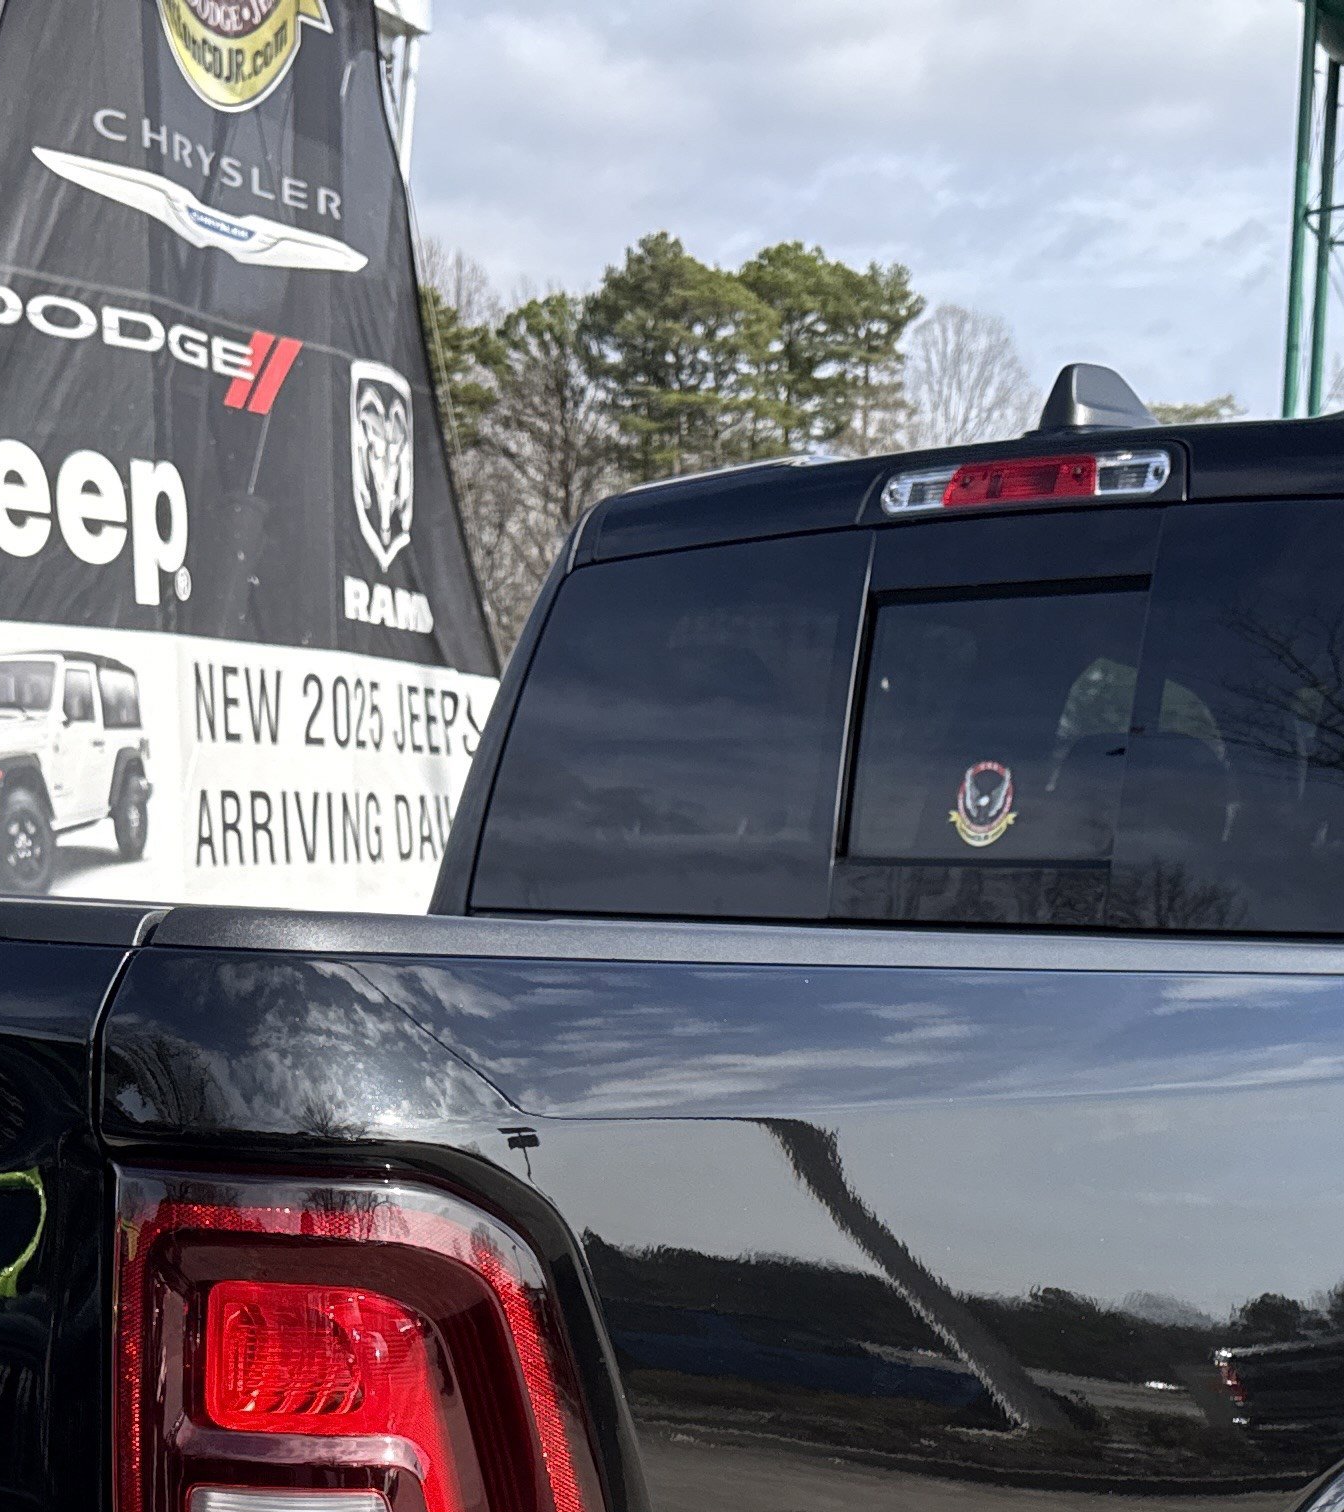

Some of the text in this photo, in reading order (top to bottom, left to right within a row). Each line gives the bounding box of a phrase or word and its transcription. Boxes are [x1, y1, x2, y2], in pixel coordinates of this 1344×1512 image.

[92, 107, 343, 220] CHRYSLER
[343, 575, 434, 634] RAM
[193, 661, 281, 745] NEW
[303, 673, 384, 749] 2025
[195, 789, 382, 867] ARRIVING
